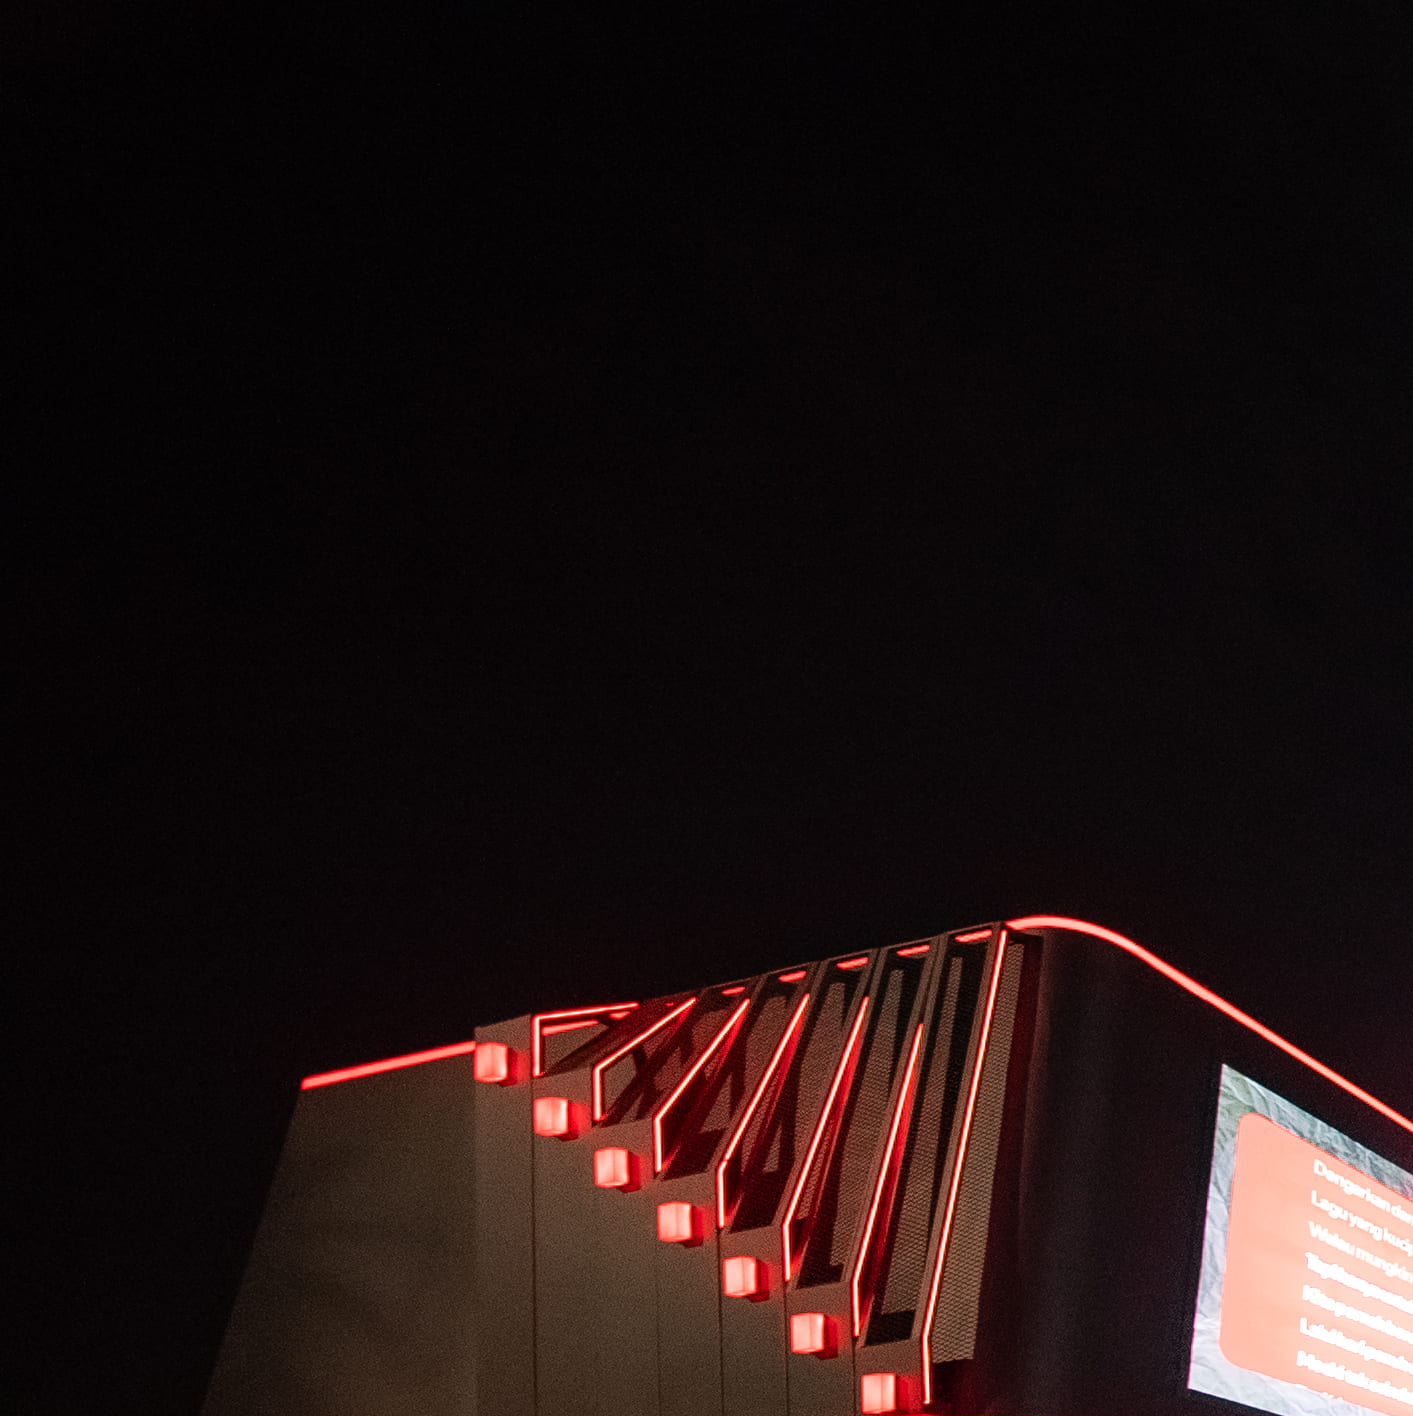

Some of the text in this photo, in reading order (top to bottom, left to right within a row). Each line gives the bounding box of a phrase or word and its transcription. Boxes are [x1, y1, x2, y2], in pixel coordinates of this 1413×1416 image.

[1313, 1159, 1390, 1212] Dengarkan
[1311, 1190, 1348, 1220] Lagu
[1348, 1212, 1382, 1240] yang
